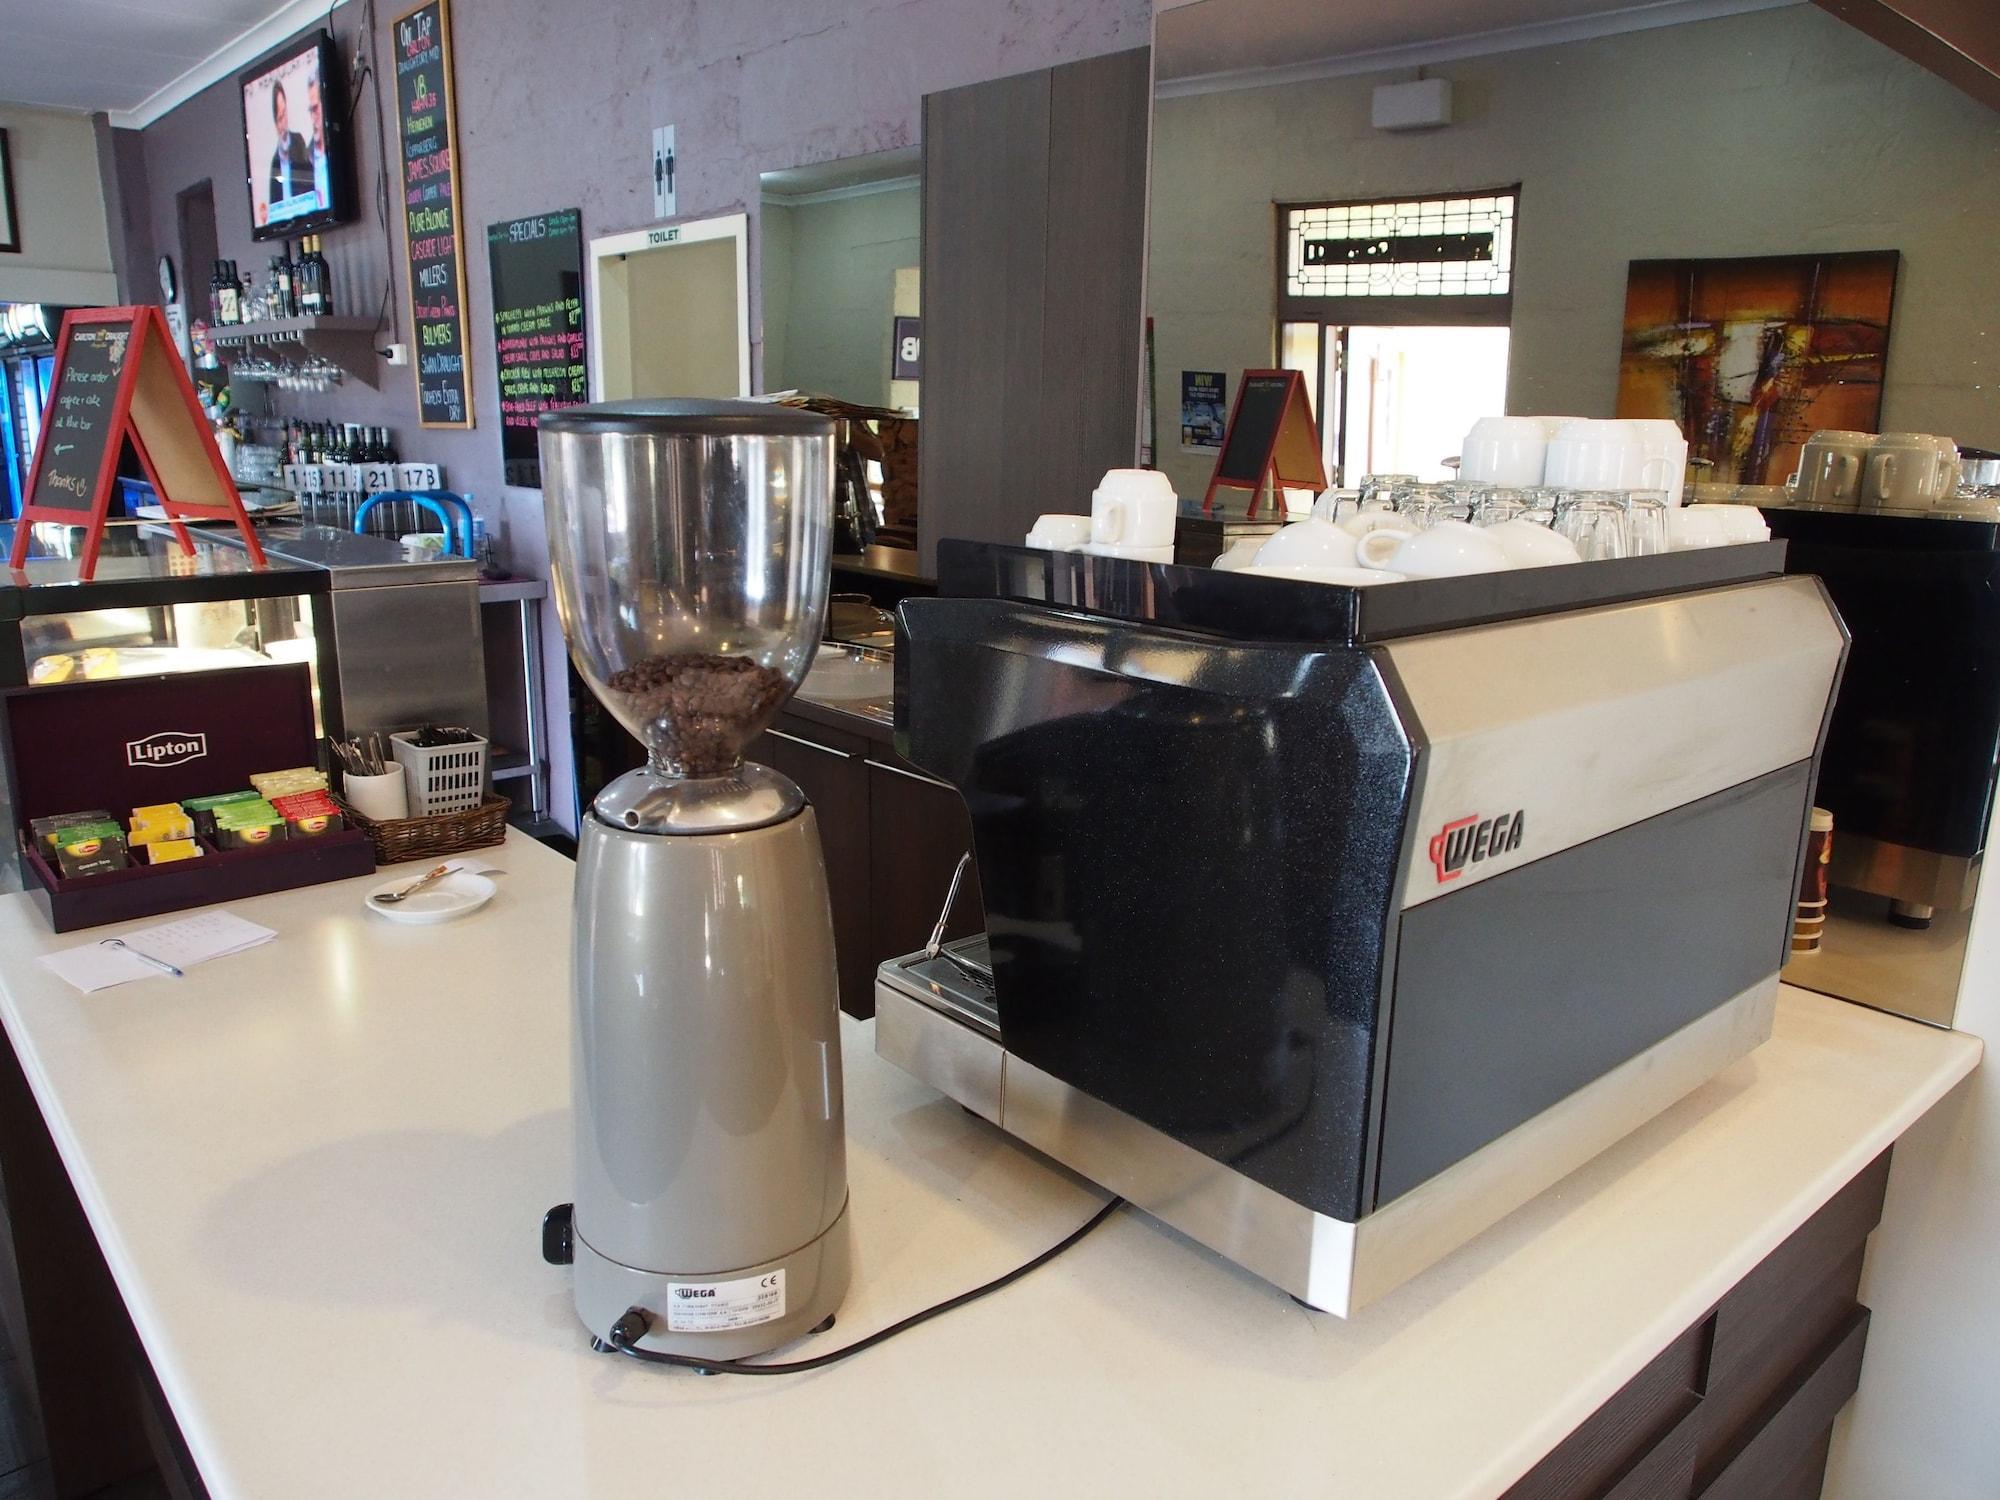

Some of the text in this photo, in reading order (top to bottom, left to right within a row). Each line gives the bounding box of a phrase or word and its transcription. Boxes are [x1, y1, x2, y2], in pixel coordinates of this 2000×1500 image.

[413, 11, 432, 40] TAP
[413, 74, 427, 99] VB
[407, 157, 428, 182] JAMES
[409, 207, 450, 233] PURE BLONDE
[509, 217, 546, 242] SPECIALS
[648, 228, 679, 244] TOILET
[411, 238, 436, 261] CASCADE
[419, 263, 447, 288] MILLERS
[422, 322, 452, 346] BULMERS
[421, 354, 437, 374] SWAN
[90, 371, 109, 384] order
[449, 405, 460, 421] DRY
[290, 469, 297, 486] 1
[328, 471, 346, 487] 11
[369, 470, 387, 488] 21
[403, 469, 422, 487] 17
[134, 741, 199, 761] Lipton
[1444, 809, 1525, 873] WEGA
[680, 1288, 716, 1300] WEGA
